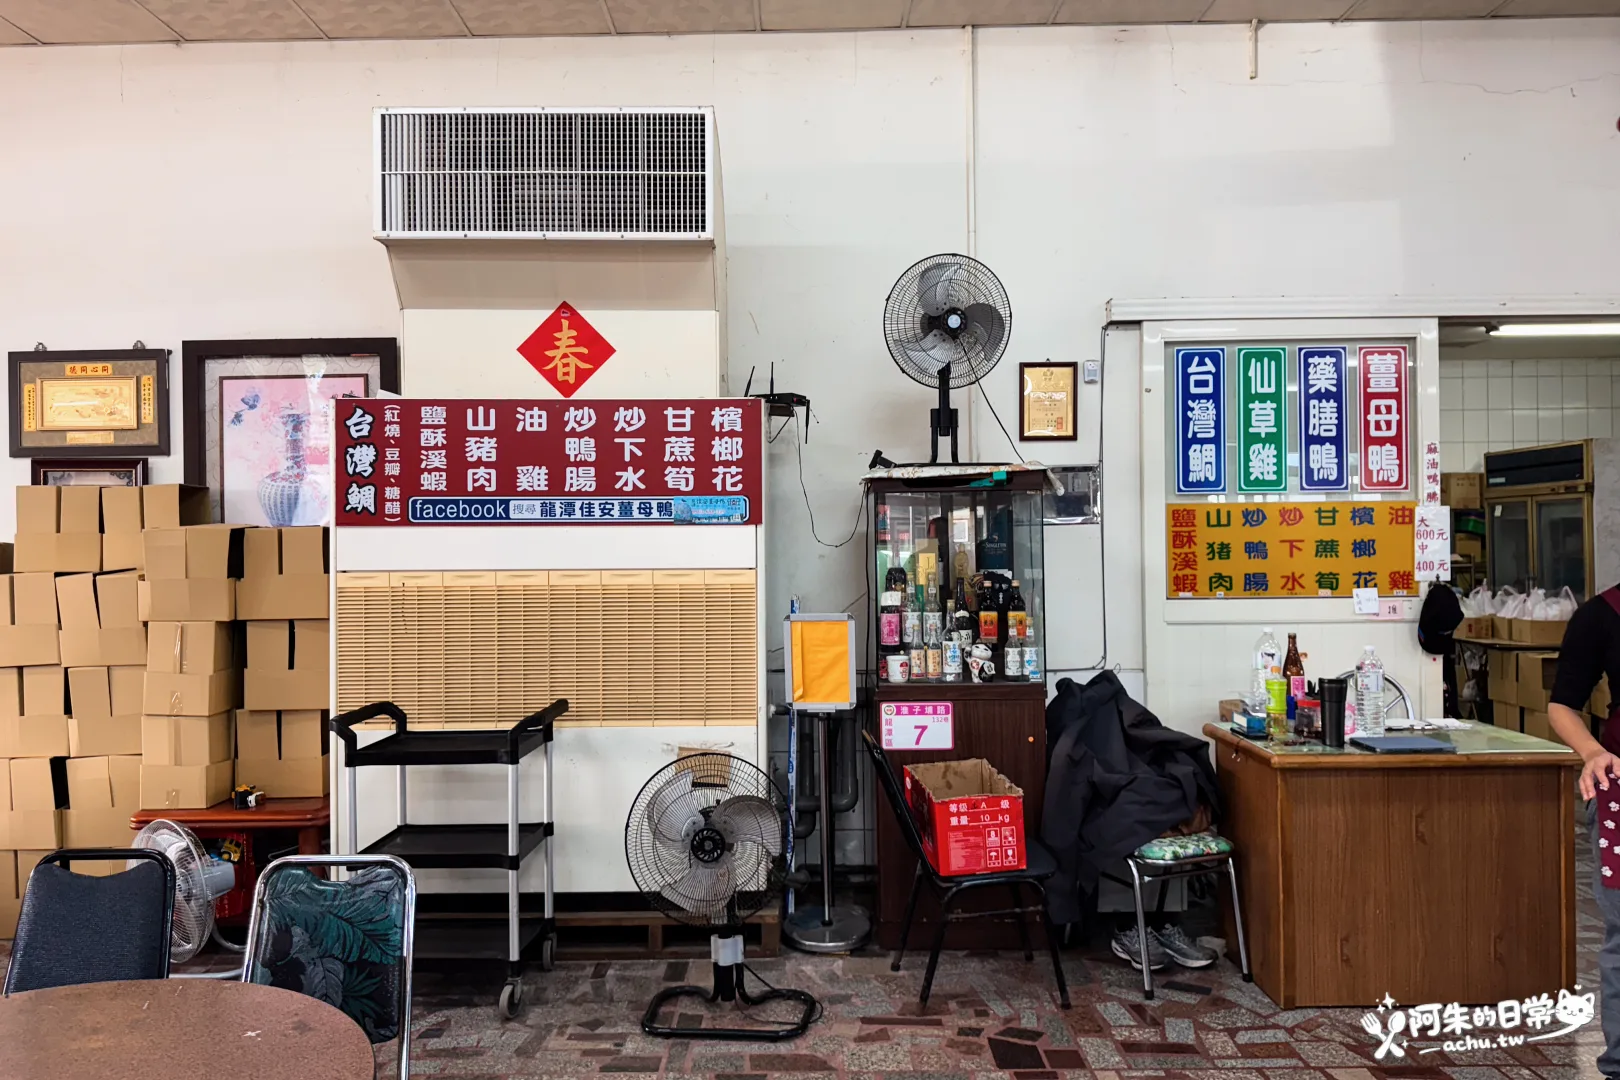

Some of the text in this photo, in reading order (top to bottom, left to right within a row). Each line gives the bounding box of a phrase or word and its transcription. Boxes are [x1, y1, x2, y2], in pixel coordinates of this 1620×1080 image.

[542, 318, 594, 384] 春
[344, 406, 378, 515] 台灣鯛
[420, 406, 448, 492] 鹽酥溪蝦
[465, 406, 498, 492] 山豬肉
[515, 406, 549, 492] 油雞
[563, 406, 597, 492] 炒鴨腸
[613, 406, 647, 492] 炒下水
[663, 406, 696, 492] 甘蔗筍
[711, 406, 744, 492] 檳榔花
[1186, 355, 1217, 483] 台灣鯛
[1248, 356, 1278, 481] 仙草雞
[1307, 355, 1339, 482] 藥膳鴨
[1366, 352, 1400, 483] 薑母鴨
[415, 500, 506, 518] facebook
[512, 503, 537, 515] 搜尋
[540, 501, 673, 518] 龍潭佳安薑母鴨
[1171, 508, 1198, 593] 鹽酥溪蝦
[1241, 507, 1269, 592] 炒鴨腸
[1278, 507, 1305, 592] 炒下水
[1314, 506, 1341, 592] 甘蔗筍
[1350, 506, 1378, 589] 檳榔花
[1387, 505, 1414, 592] 油雞
[1416, 528, 1449, 541] 600元
[1417, 516, 1430, 528] 大
[1417, 542, 1429, 555] 中
[1416, 560, 1449, 572] 400元
[913, 725, 928, 746] 7
[980, 814, 990, 822] 10
